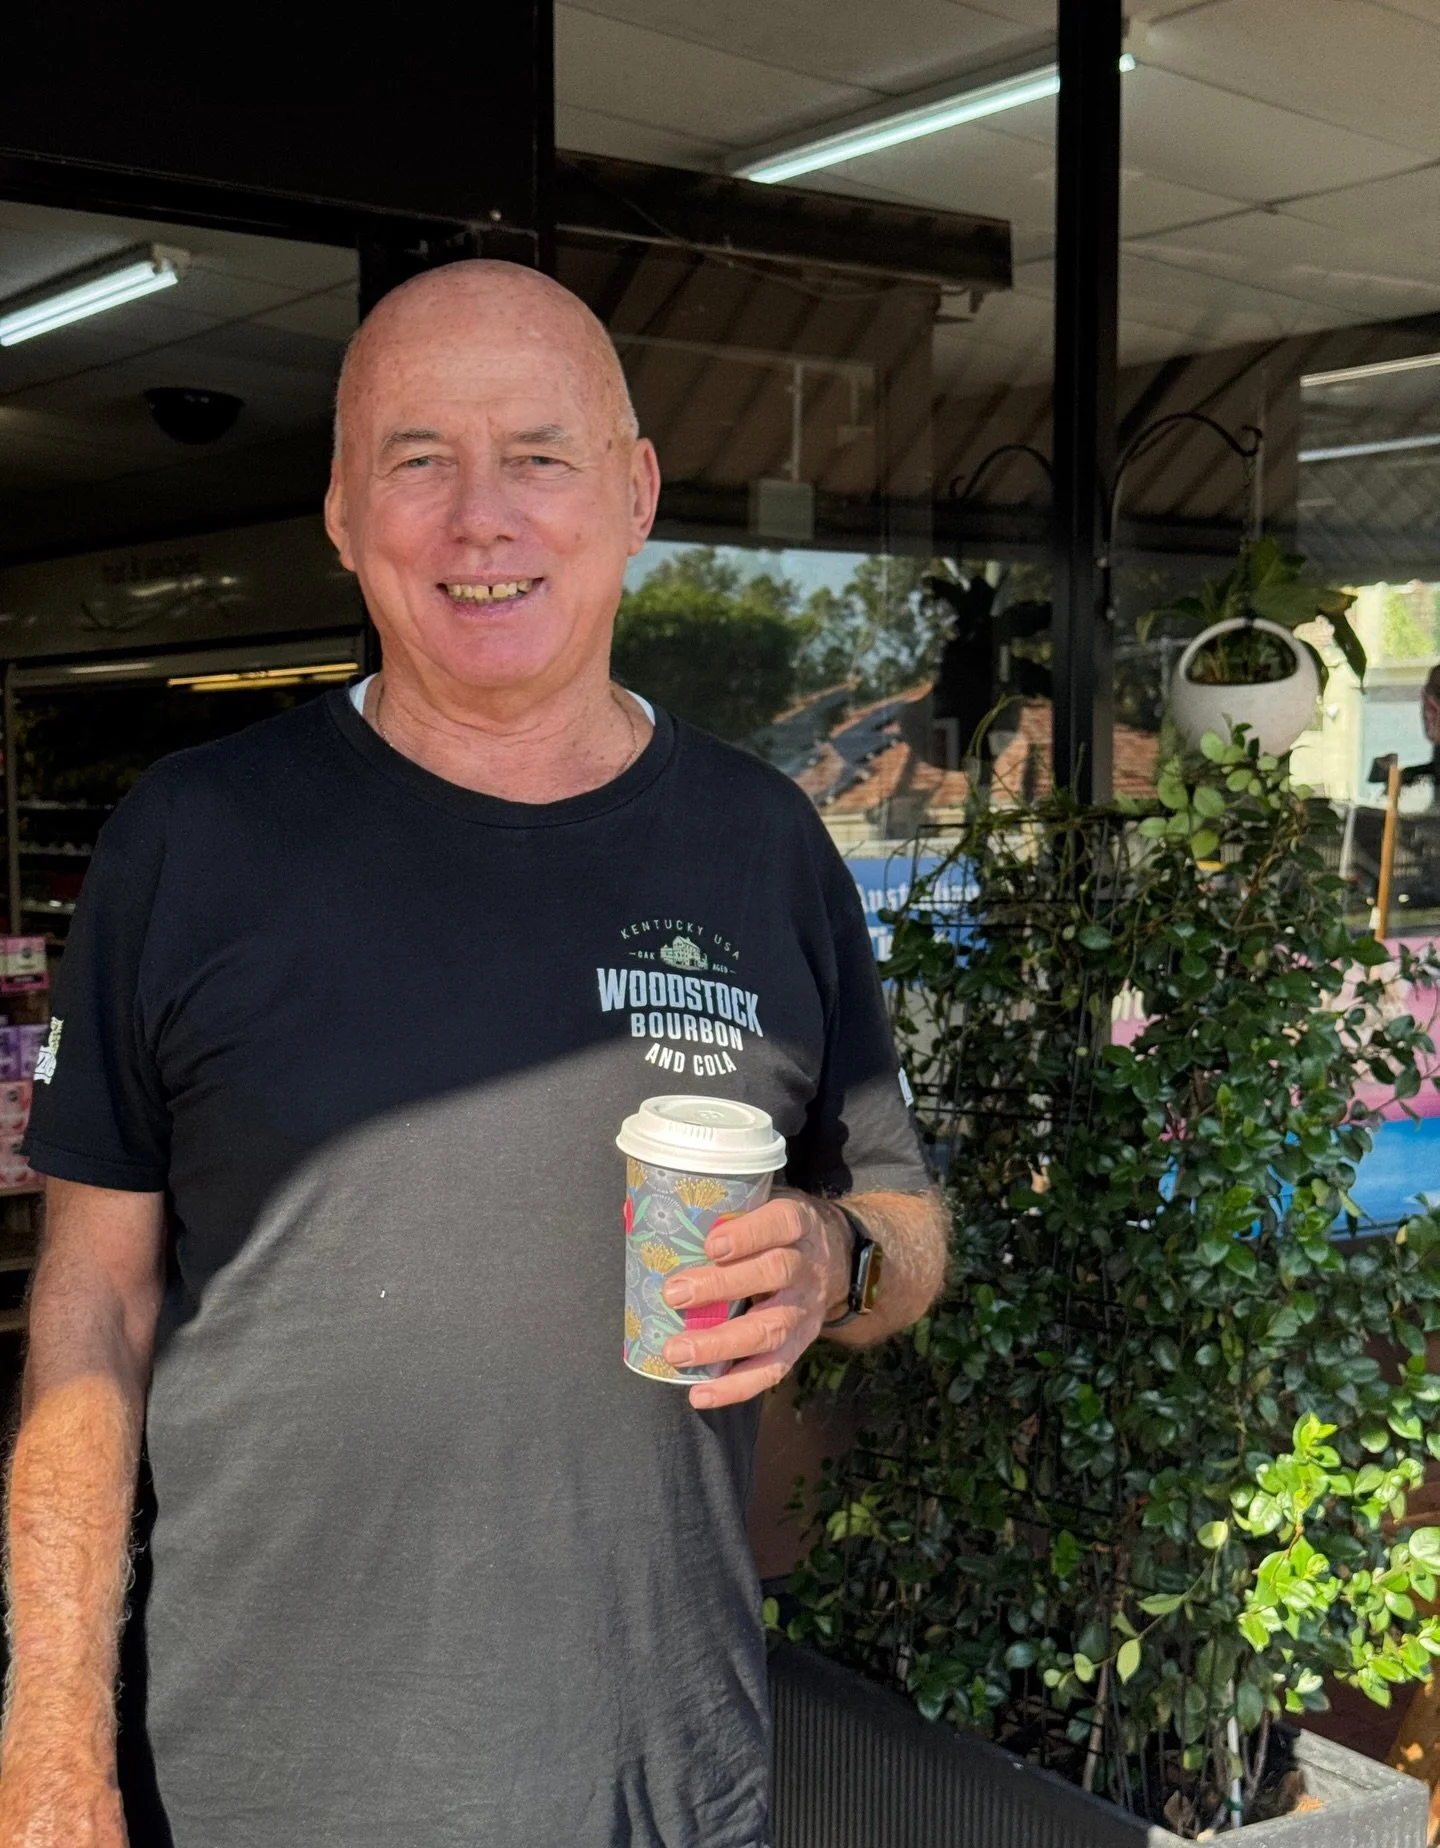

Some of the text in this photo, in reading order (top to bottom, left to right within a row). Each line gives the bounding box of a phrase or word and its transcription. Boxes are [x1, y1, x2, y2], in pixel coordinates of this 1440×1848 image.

[620, 919, 740, 960] KENTUCKY USA
[637, 950, 729, 974] OAK AGED
[596, 967, 764, 1038] WOODSTOCK
[631, 1011, 744, 1052] BOURBON
[644, 1042, 737, 1076] AND COLA
